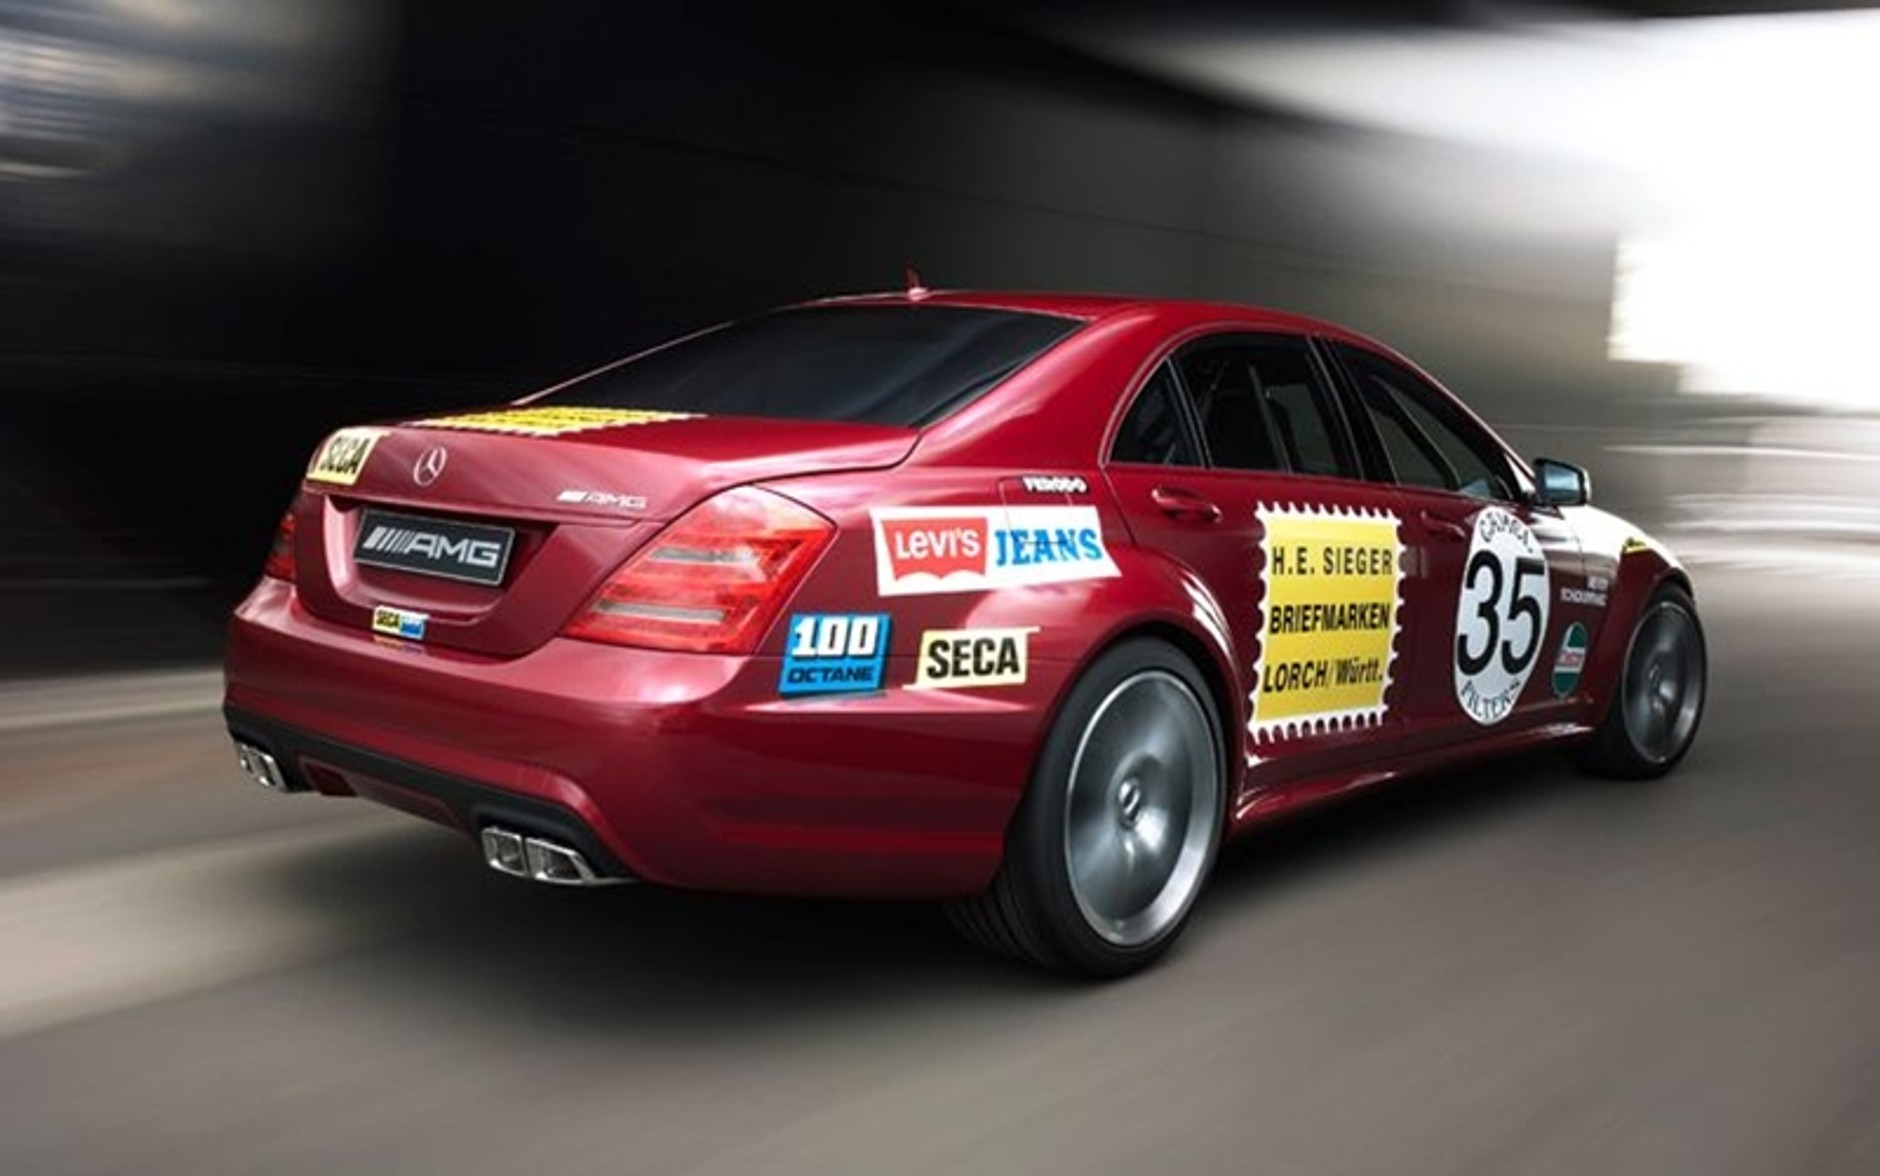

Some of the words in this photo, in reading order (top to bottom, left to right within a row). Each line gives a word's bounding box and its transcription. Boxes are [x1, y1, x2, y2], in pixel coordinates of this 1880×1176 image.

[403, 531, 501, 568] AMG
[995, 528, 1102, 567] JEANS
[1272, 547, 1315, 575] H.E.
[1323, 548, 1393, 575] SIEGER
[1269, 603, 1390, 634] BRIEFMARKEN
[1458, 550, 1545, 676] 35
[791, 616, 879, 656] 100
[787, 666, 875, 684] OCTANE
[926, 637, 1020, 679] SECA
